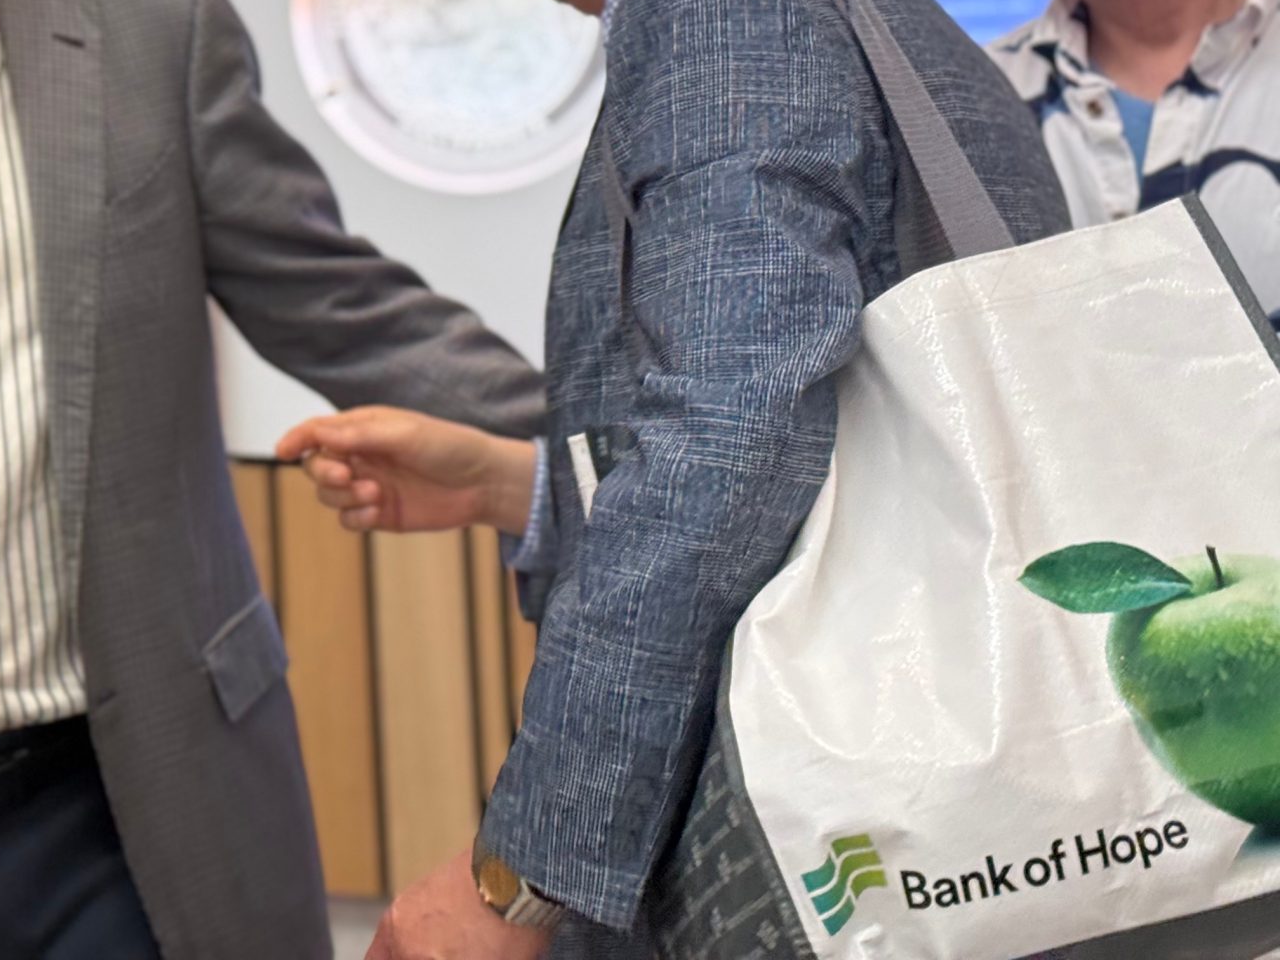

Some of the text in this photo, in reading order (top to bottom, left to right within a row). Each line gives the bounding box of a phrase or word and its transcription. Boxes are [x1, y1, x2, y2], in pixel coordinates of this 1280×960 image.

[900, 820, 1189, 910] Bank of Hope
